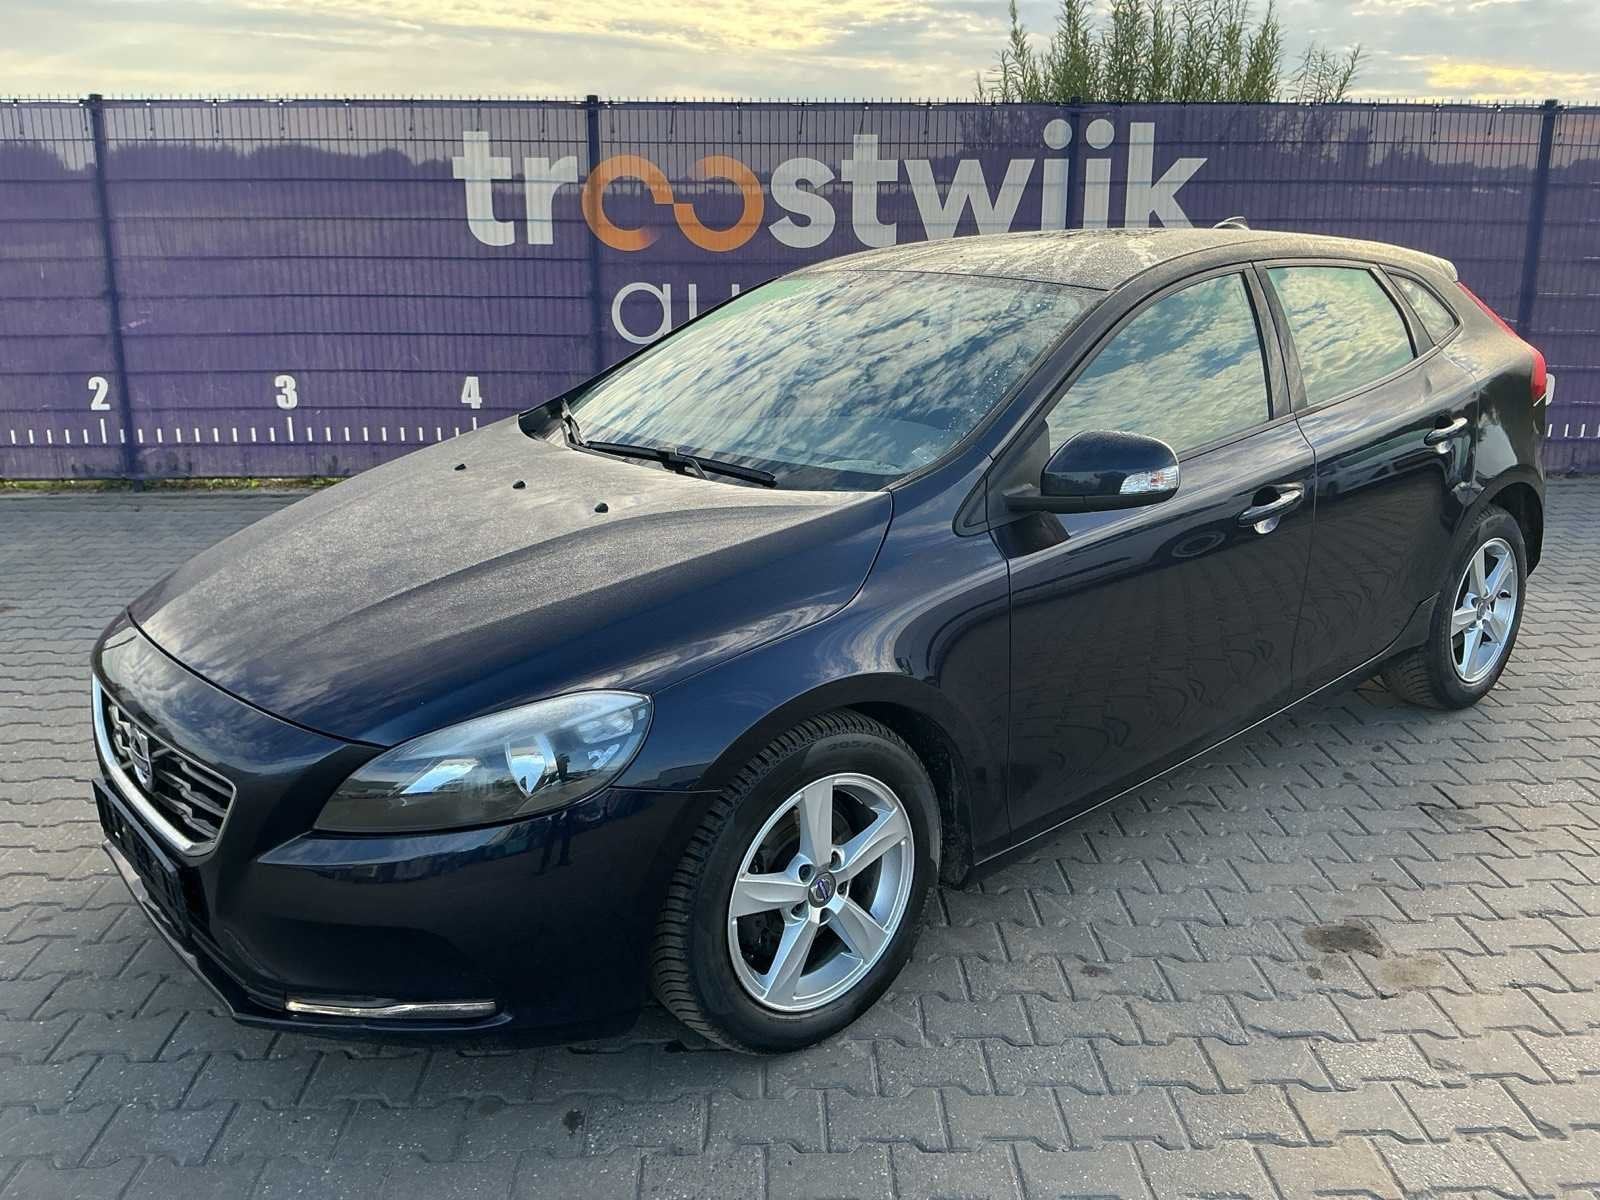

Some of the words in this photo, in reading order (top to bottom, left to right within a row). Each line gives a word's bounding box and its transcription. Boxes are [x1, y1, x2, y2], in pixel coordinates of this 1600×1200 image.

[88, 376, 110, 411] 2
[275, 375, 298, 409] 3
[461, 376, 482, 409] 4
